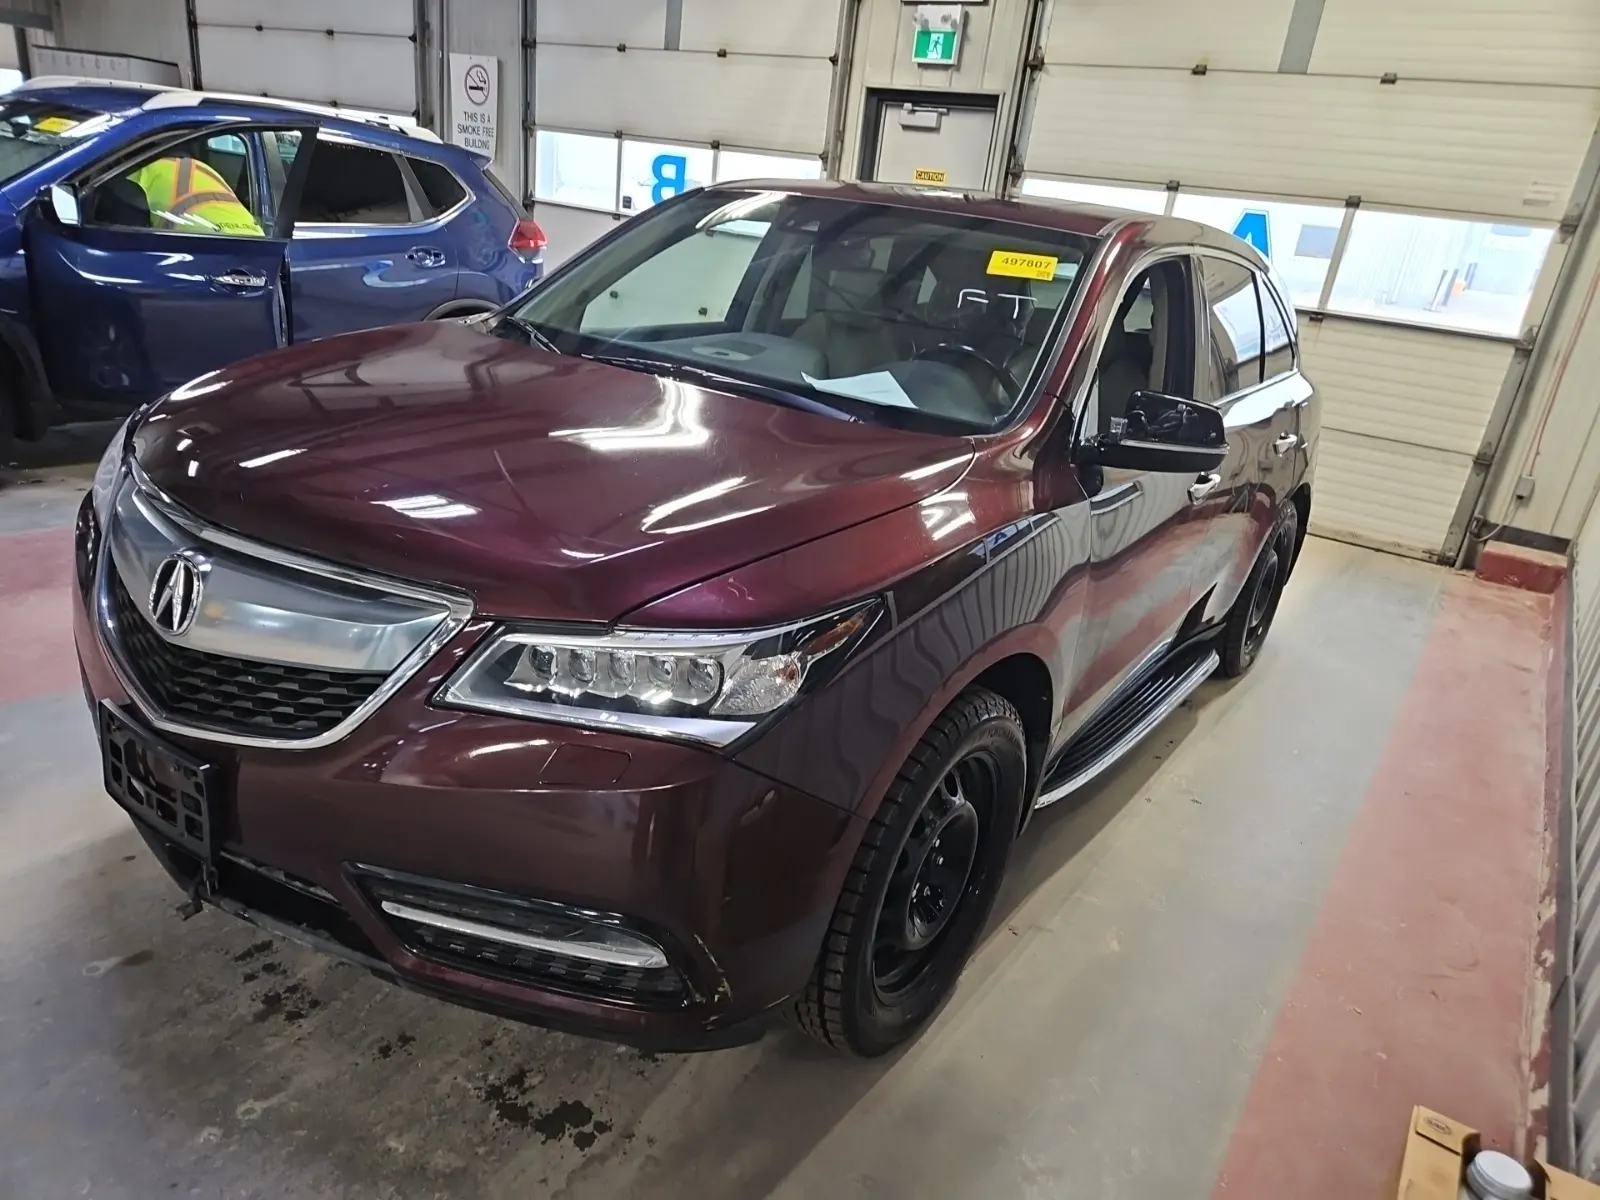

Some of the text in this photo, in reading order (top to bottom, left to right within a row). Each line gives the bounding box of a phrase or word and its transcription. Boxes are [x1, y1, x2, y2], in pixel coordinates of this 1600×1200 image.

[463, 111, 491, 123] THIS IS A
[457, 123, 494, 138] SMOKE FREE
[464, 138, 490, 150] BUILDING
[916, 171, 944, 181] CAUTION
[1001, 257, 1052, 269] 497807
